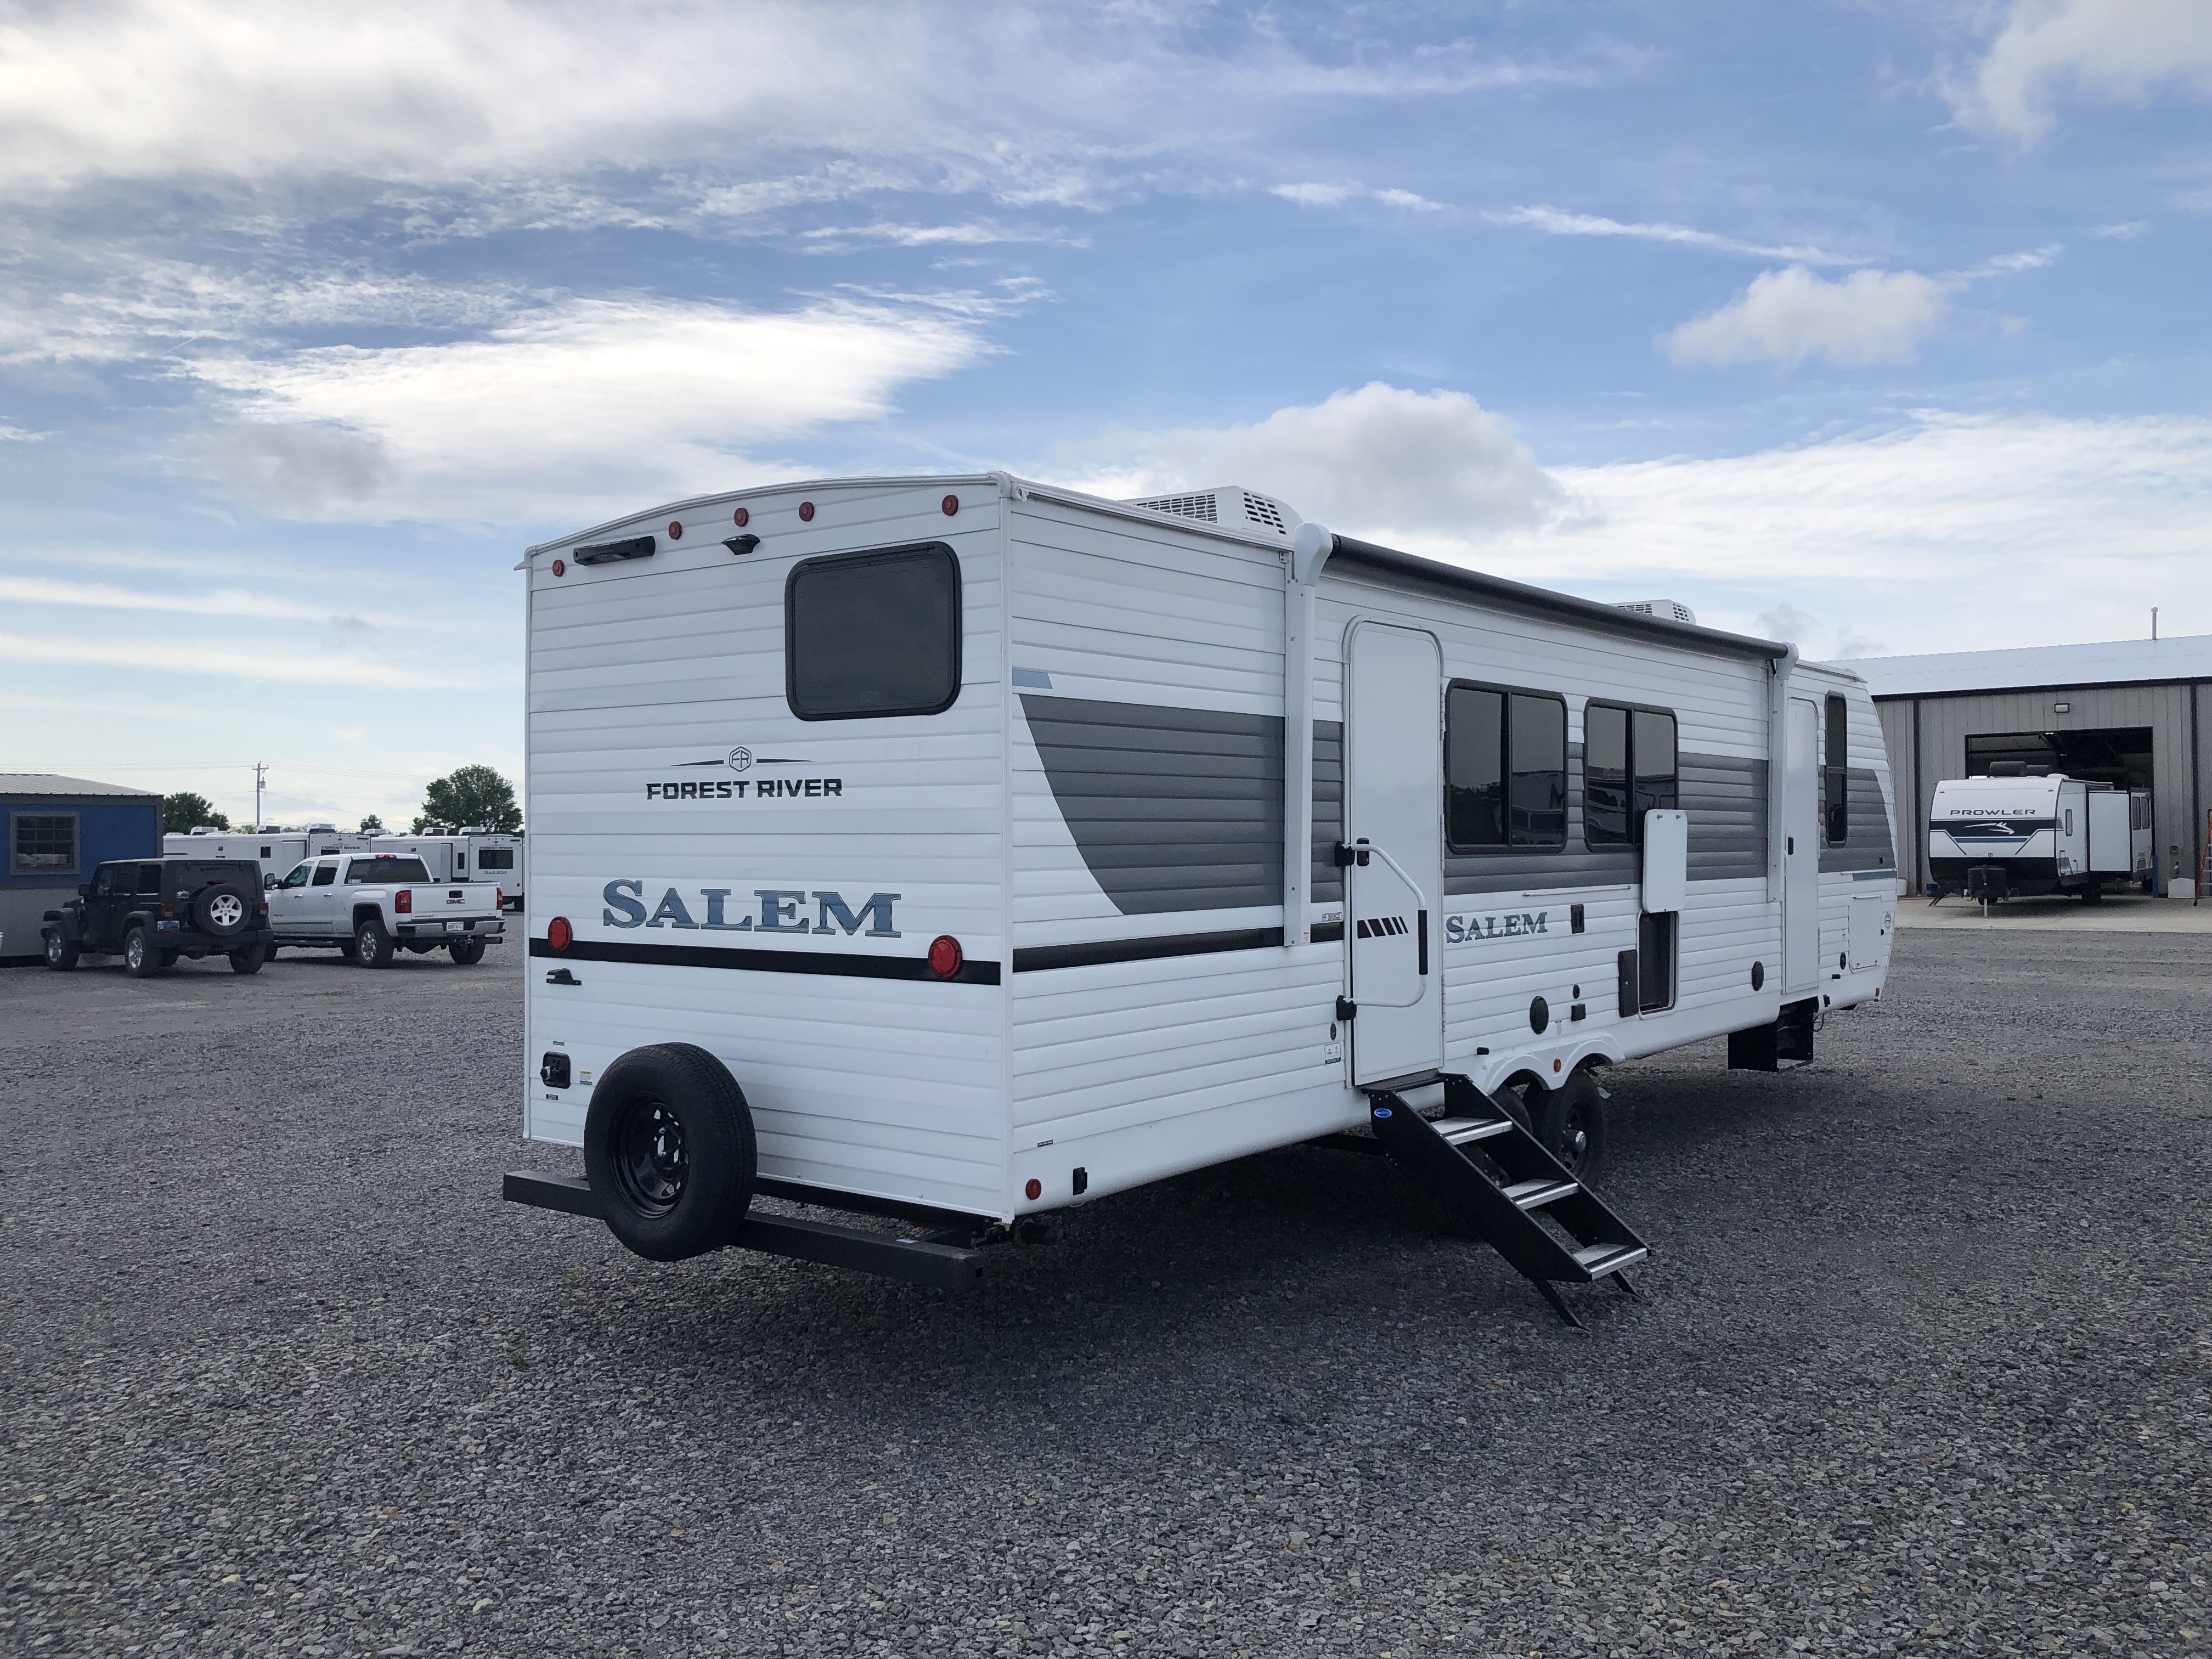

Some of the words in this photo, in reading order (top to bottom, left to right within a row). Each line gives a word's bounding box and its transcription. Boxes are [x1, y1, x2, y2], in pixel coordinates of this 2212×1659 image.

[646, 780, 751, 800] FOREST
[756, 778, 843, 798] RIVER
[603, 879, 901, 938] SALEM
[1446, 912, 1548, 944] SALEM
